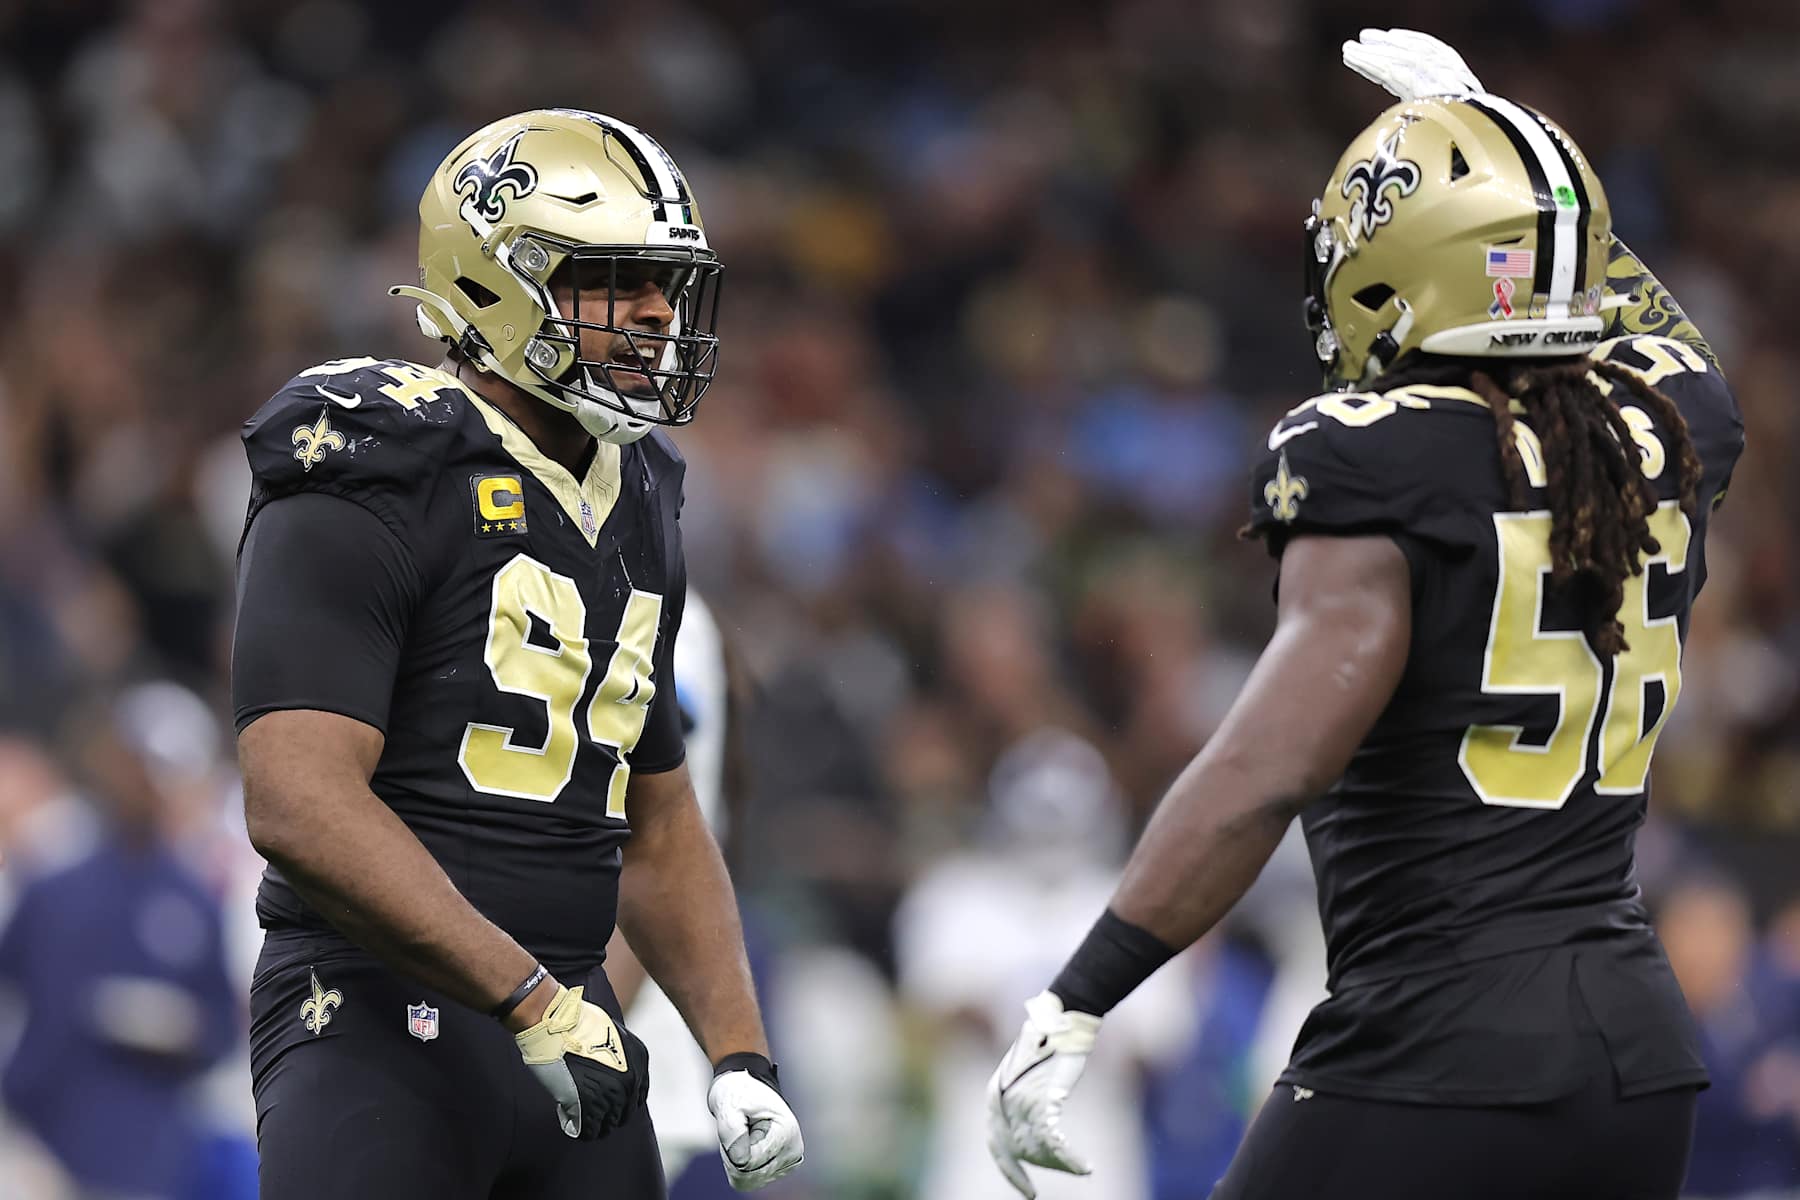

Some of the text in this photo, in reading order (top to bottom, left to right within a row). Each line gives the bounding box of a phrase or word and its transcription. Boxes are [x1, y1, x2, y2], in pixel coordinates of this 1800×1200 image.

[1489, 332, 1537, 348] NEW
[477, 477, 524, 521] C
[457, 552, 663, 820] 94
[1457, 499, 1692, 810] 56
